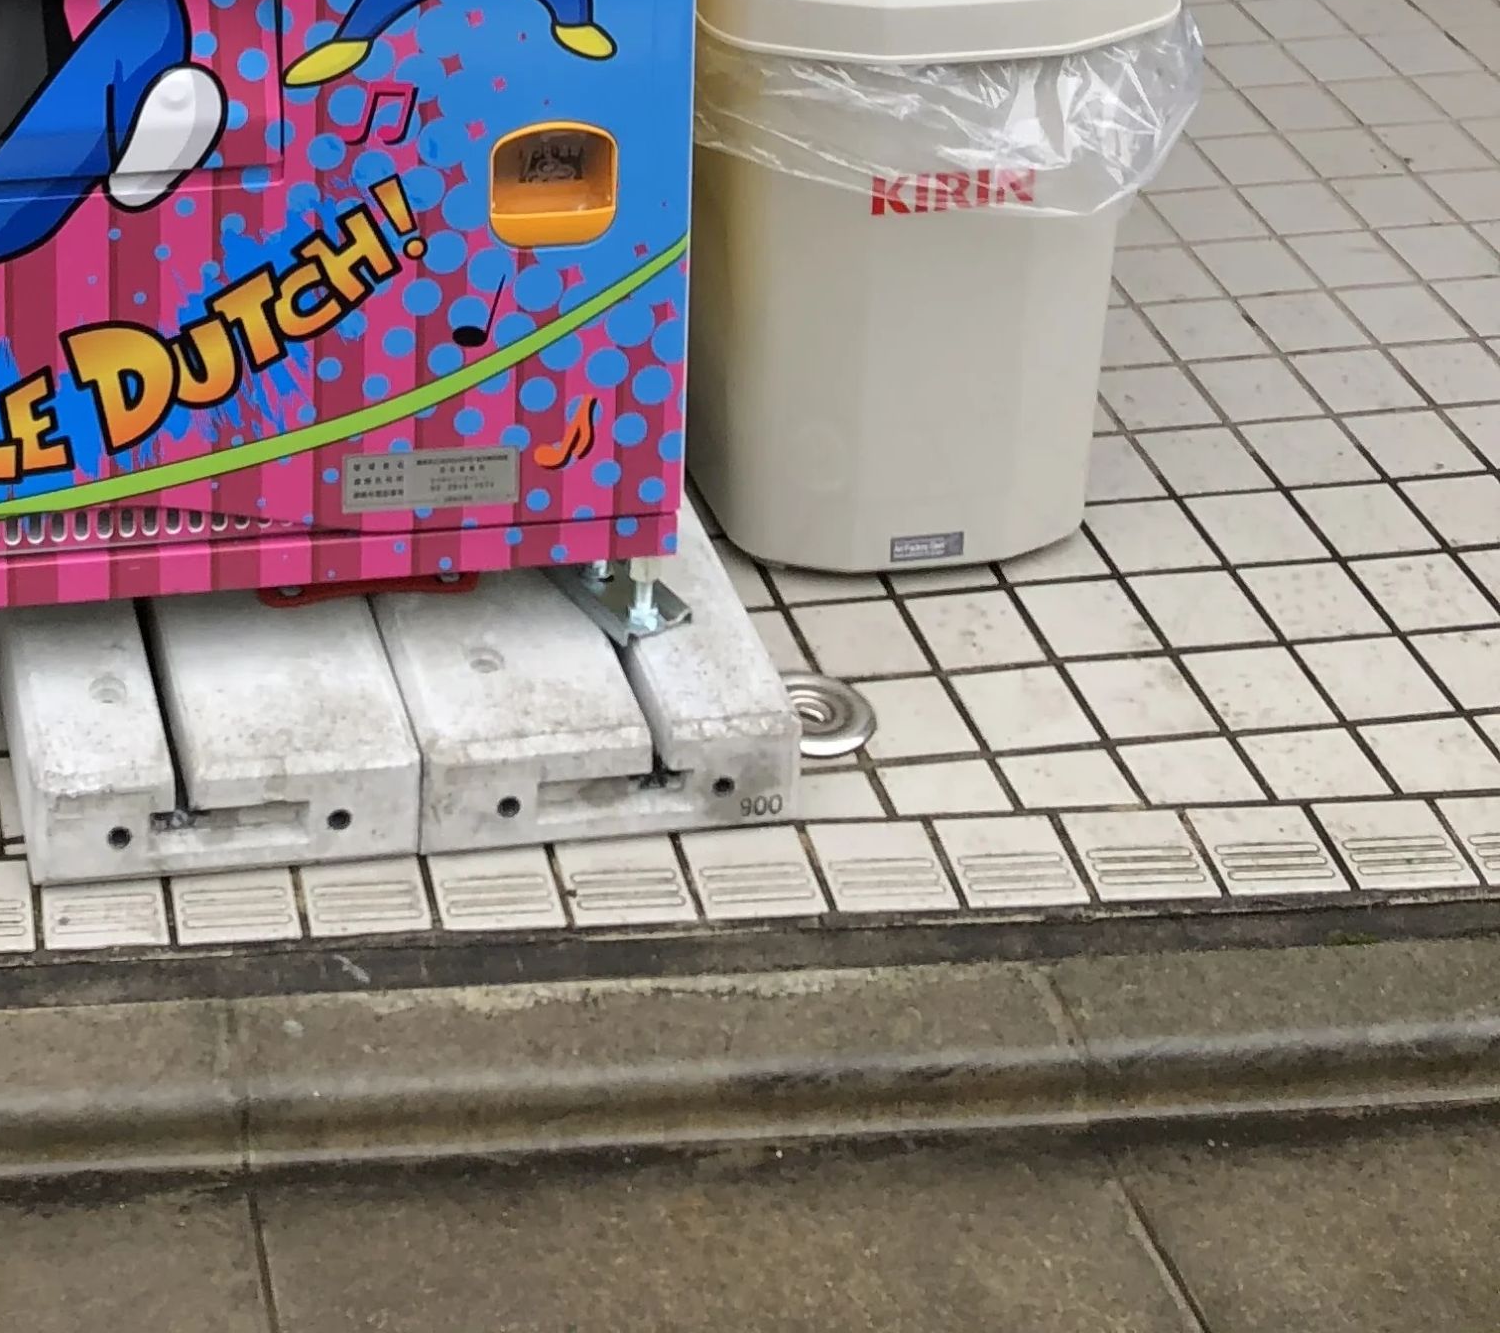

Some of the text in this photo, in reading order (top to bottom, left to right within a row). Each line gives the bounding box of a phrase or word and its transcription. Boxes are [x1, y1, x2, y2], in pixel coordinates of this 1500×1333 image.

[870, 166, 1037, 217] KIRIN
[60, 173, 429, 452] DUTCH!
[740, 794, 783, 817] 900
